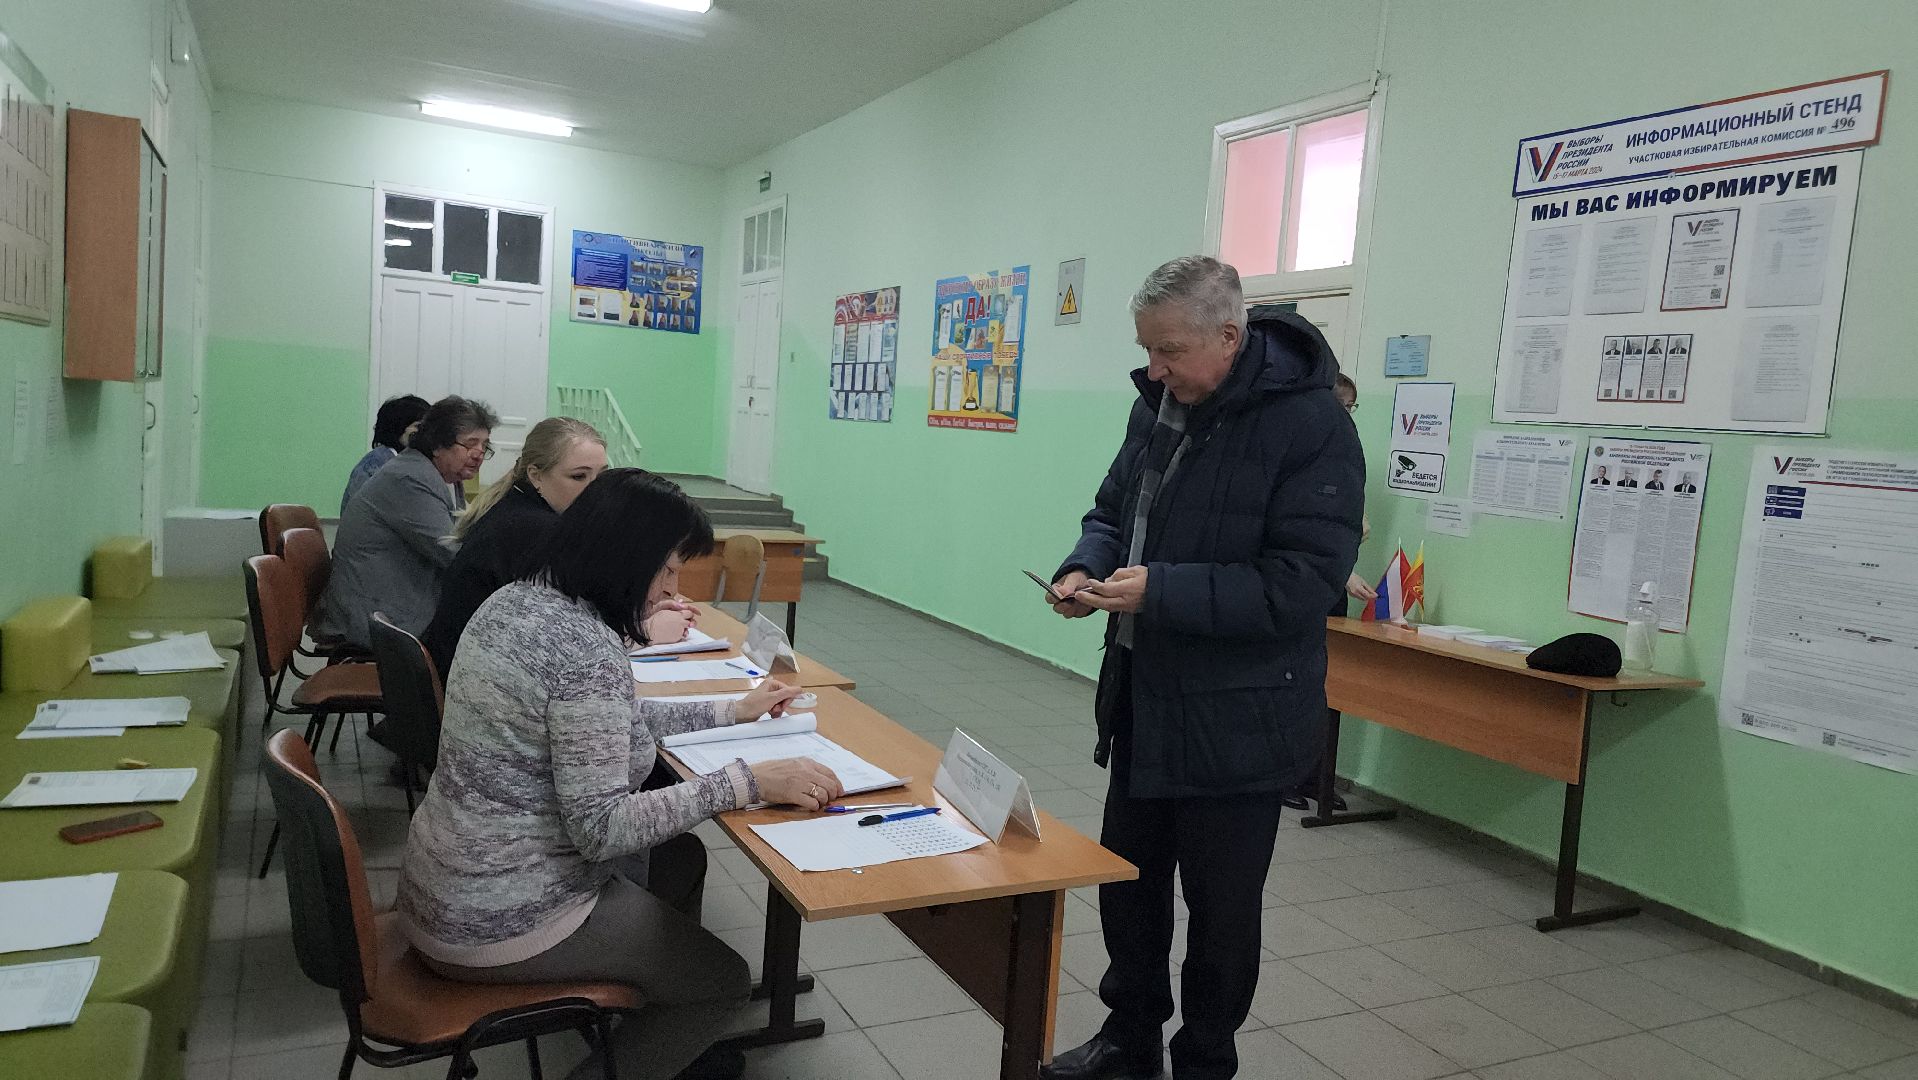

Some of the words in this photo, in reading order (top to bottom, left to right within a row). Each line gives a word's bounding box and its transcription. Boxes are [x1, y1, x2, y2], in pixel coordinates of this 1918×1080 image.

[1625, 102, 1794, 149] ИНФОРМАЦИОННЫЙ
[1799, 93, 1863, 119] СТЕНД
[1561, 143, 1614, 160] ПРЕЗИДЕНТА
[1566, 134, 1604, 149] ВЫБОРЫ
[1628, 149, 1682, 164] УЧАСТКОВАЯ
[1683, 136, 1759, 156] ИЗБИРАТЕЛЬНАЯ
[1760, 128, 1814, 144] КОМИССИЯ
[1830, 115, 1857, 131] 496
[1556, 157, 1590, 171] РОССИИ
[1530, 200, 1569, 222] МЫ
[1575, 194, 1620, 216] ВАС
[1625, 165, 1838, 210] ИНФОРМИРУЕМ
[964, 294, 991, 326] ДА!
[1412, 472, 1438, 481] ВЕДЕТСЯ
